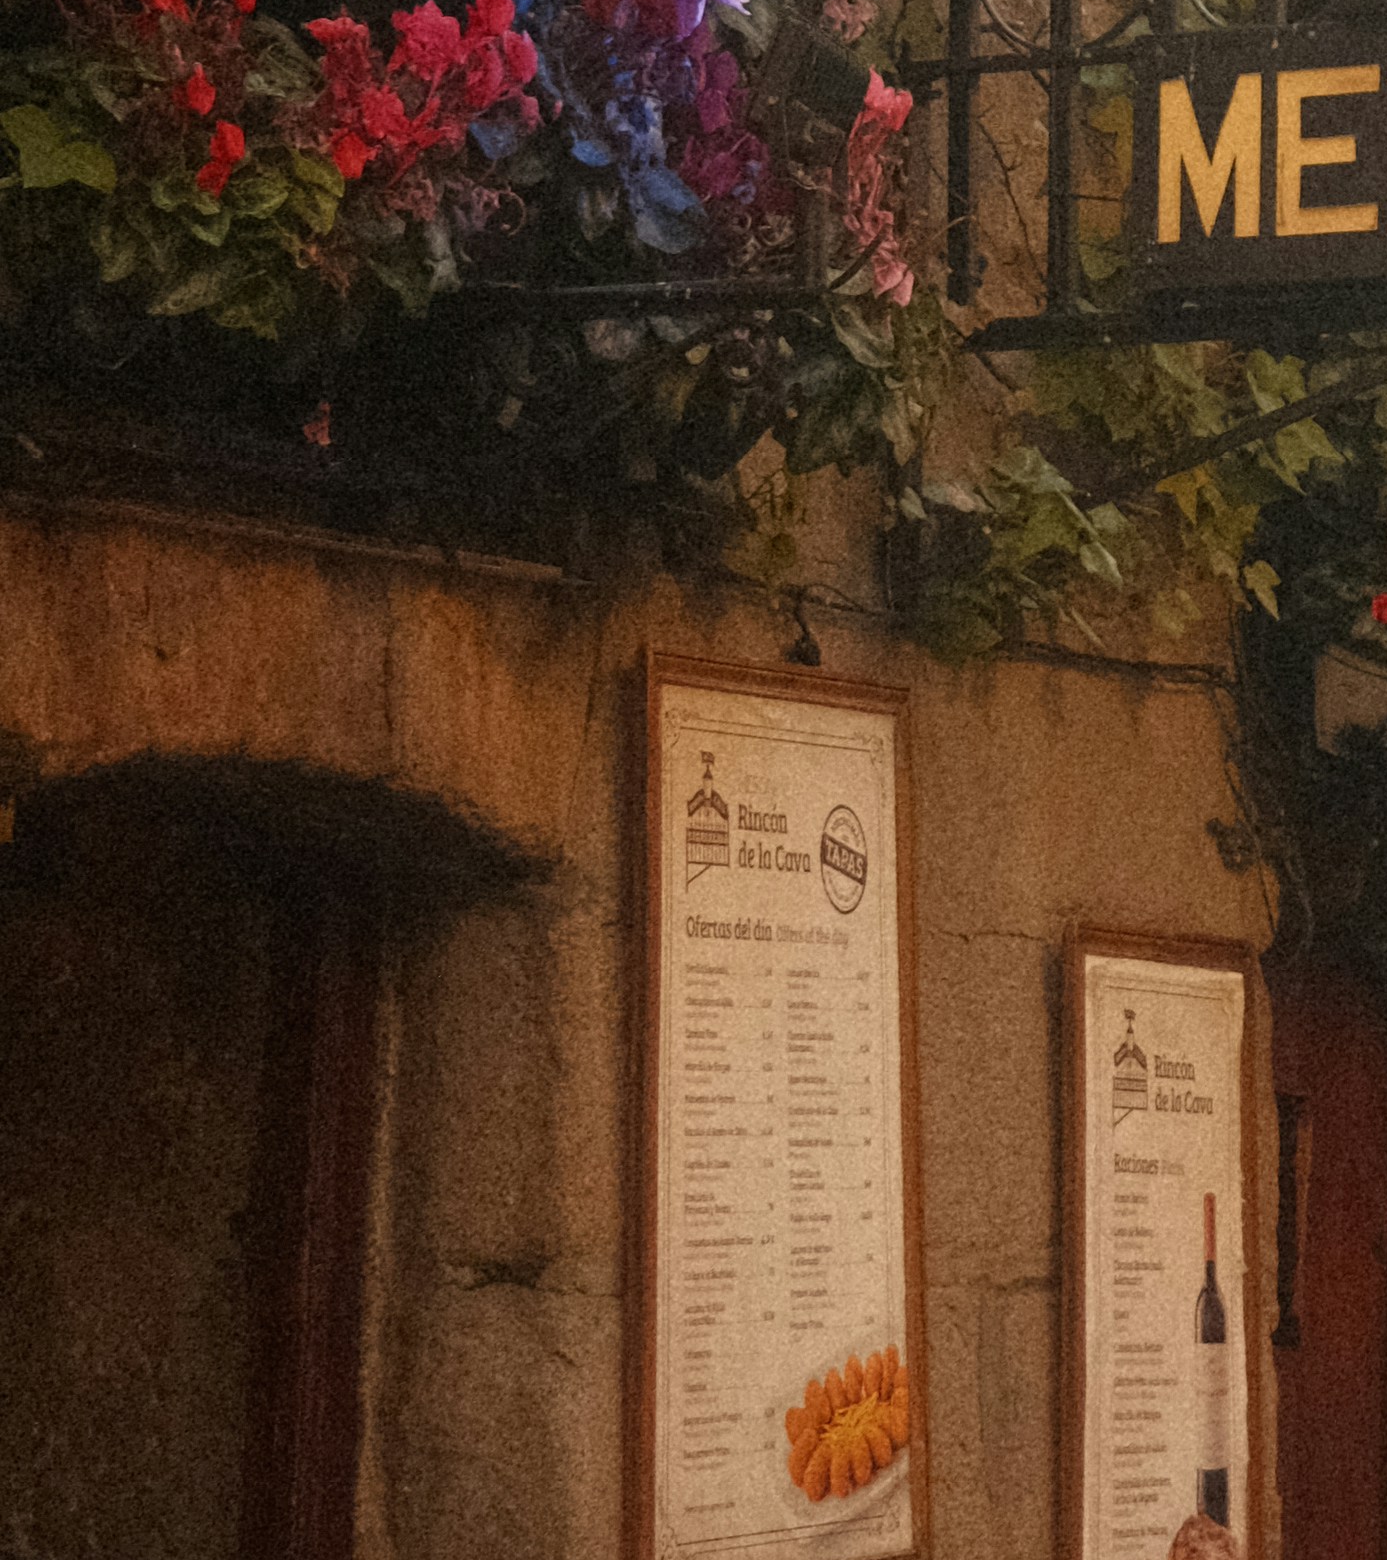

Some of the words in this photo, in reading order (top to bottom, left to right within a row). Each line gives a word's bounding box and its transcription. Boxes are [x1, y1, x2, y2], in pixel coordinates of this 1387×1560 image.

[737, 803, 788, 834] Rincón
[738, 840, 755, 869] de
[757, 842, 772, 871] la
[774, 844, 812, 873] Cava
[824, 838, 865, 879] TAPAS
[685, 914, 732, 940] Ofertas
[734, 916, 751, 941] del
[1153, 1053, 1196, 1081] Rincón
[1155, 1087, 1169, 1112] de
[1183, 1090, 1214, 1115] Cava
